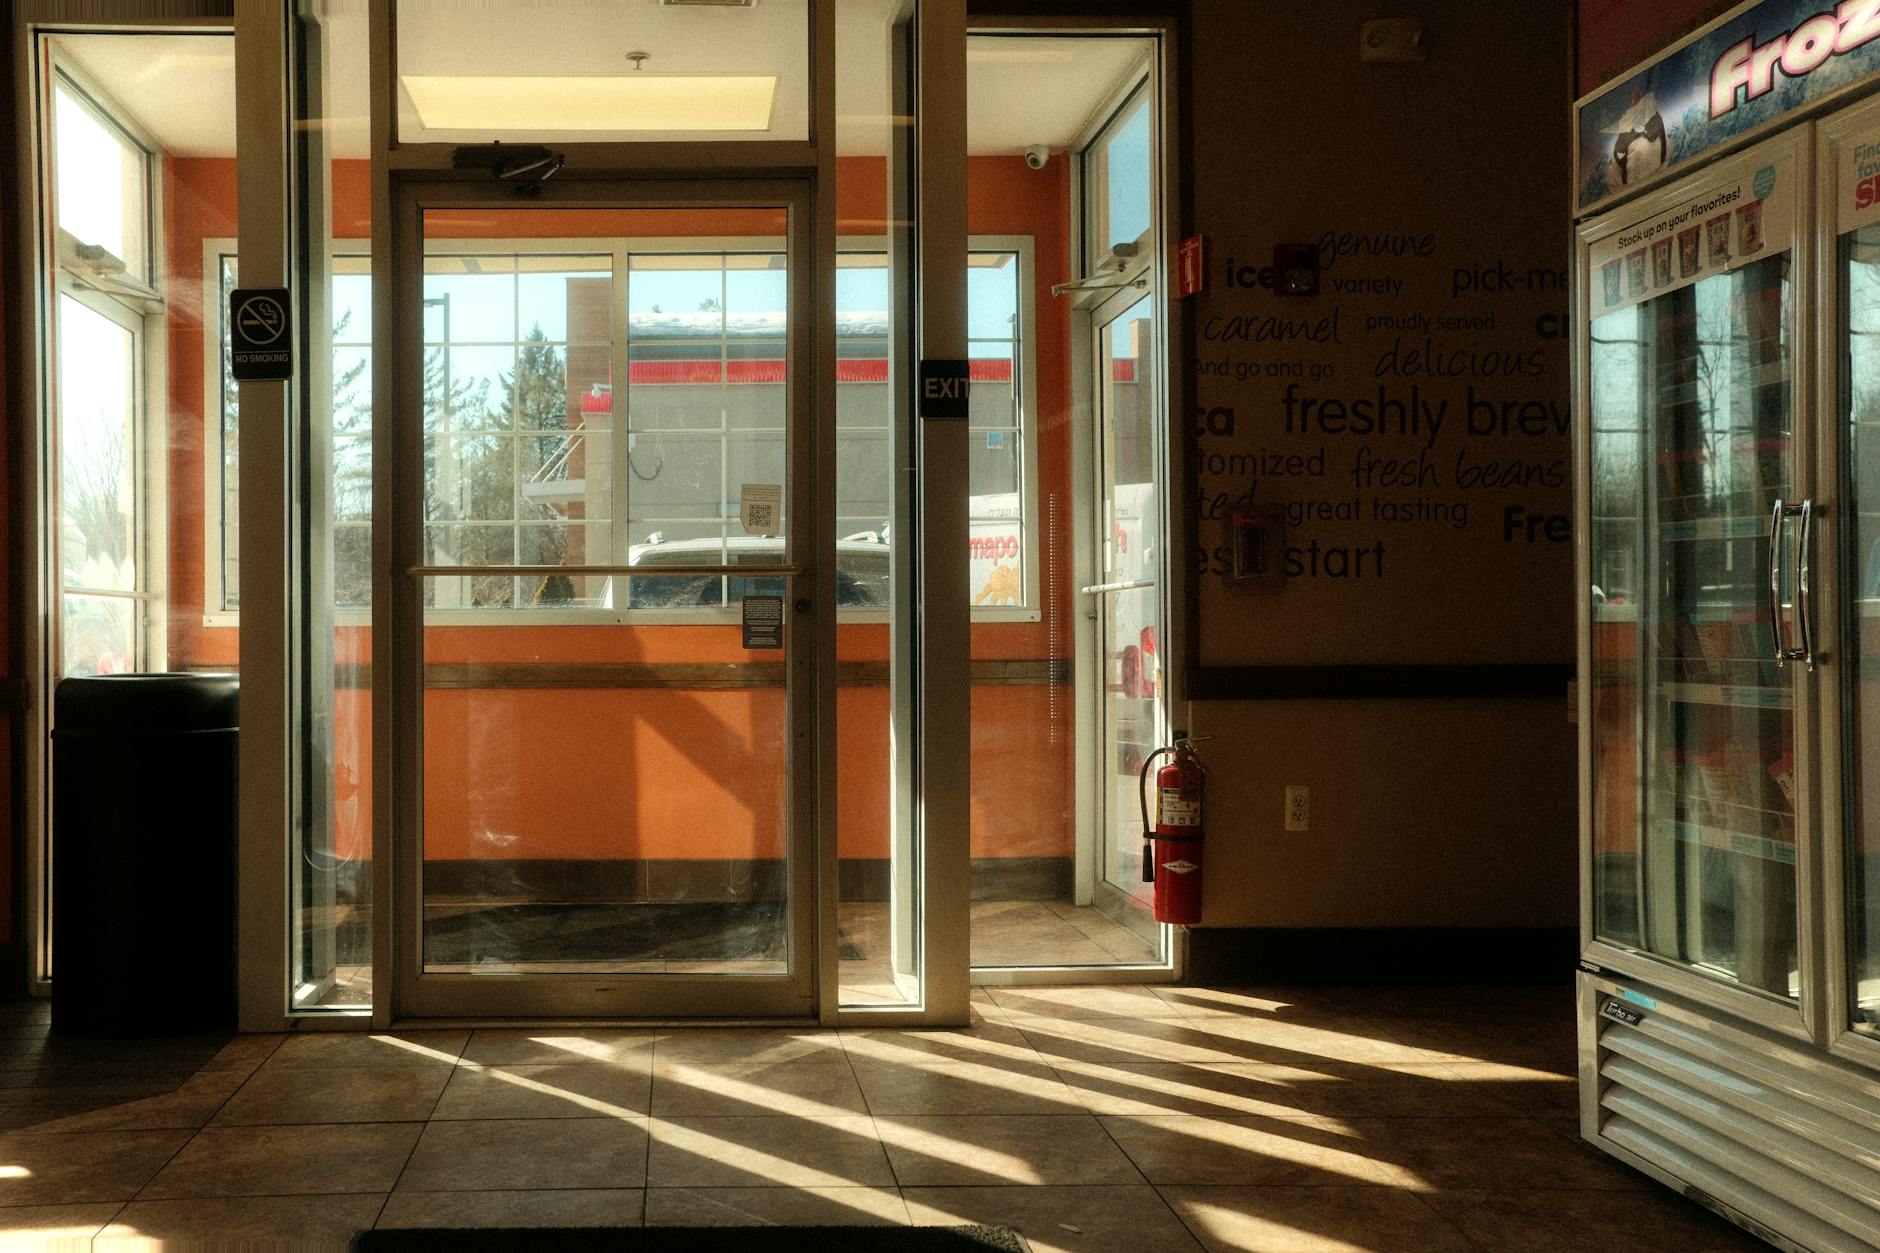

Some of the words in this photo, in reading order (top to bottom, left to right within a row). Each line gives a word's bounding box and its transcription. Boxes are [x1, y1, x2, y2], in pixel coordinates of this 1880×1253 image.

[1618, 231, 1642, 249] Stock
[1643, 226, 1655, 240] up
[1656, 220, 1667, 233] on
[1668, 211, 1690, 231] your
[1691, 186, 1741, 217] flavorites!
[1318, 231, 1436, 271] genuine
[1333, 275, 1403, 297] variety
[1204, 306, 1342, 344] caramel
[1367, 313, 1428, 333] proudly
[1437, 312, 1495, 331] served
[236, 354, 248, 363] NO
[249, 354, 289, 363] SMOKING
[1236, 362, 1260, 381] go
[1266, 358, 1303, 377] and
[1376, 337, 1545, 378] delicious
[925, 377, 969, 399] EXIT
[1282, 383, 1448, 448] freshly
[1351, 447, 1440, 487] fresh
[1456, 449, 1564, 489] beans
[1287, 498, 1362, 527] great
[1373, 498, 1467, 528] tasting
[1286, 540, 1386, 578] start
[1607, 1002, 1625, 1018] Turbo
